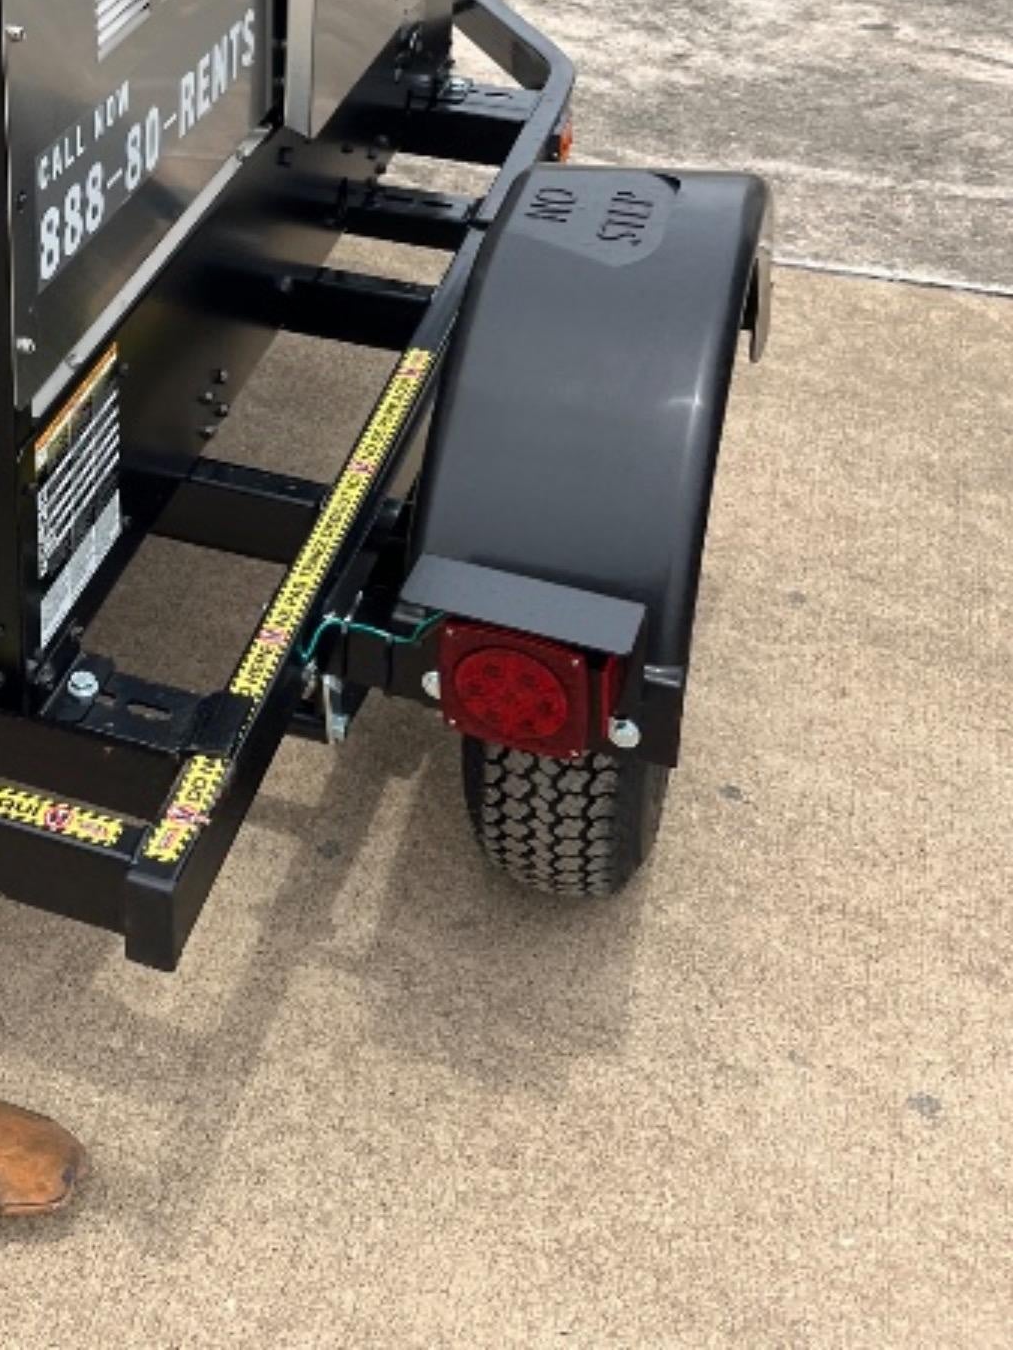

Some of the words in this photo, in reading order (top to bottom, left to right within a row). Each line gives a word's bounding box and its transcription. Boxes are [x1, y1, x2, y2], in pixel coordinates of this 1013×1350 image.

[37, 126, 85, 190] CALL
[94, 80, 130, 141] NOW
[39, 8, 256, 281] 888-80-RENTS
[525, 188, 577, 223] NO
